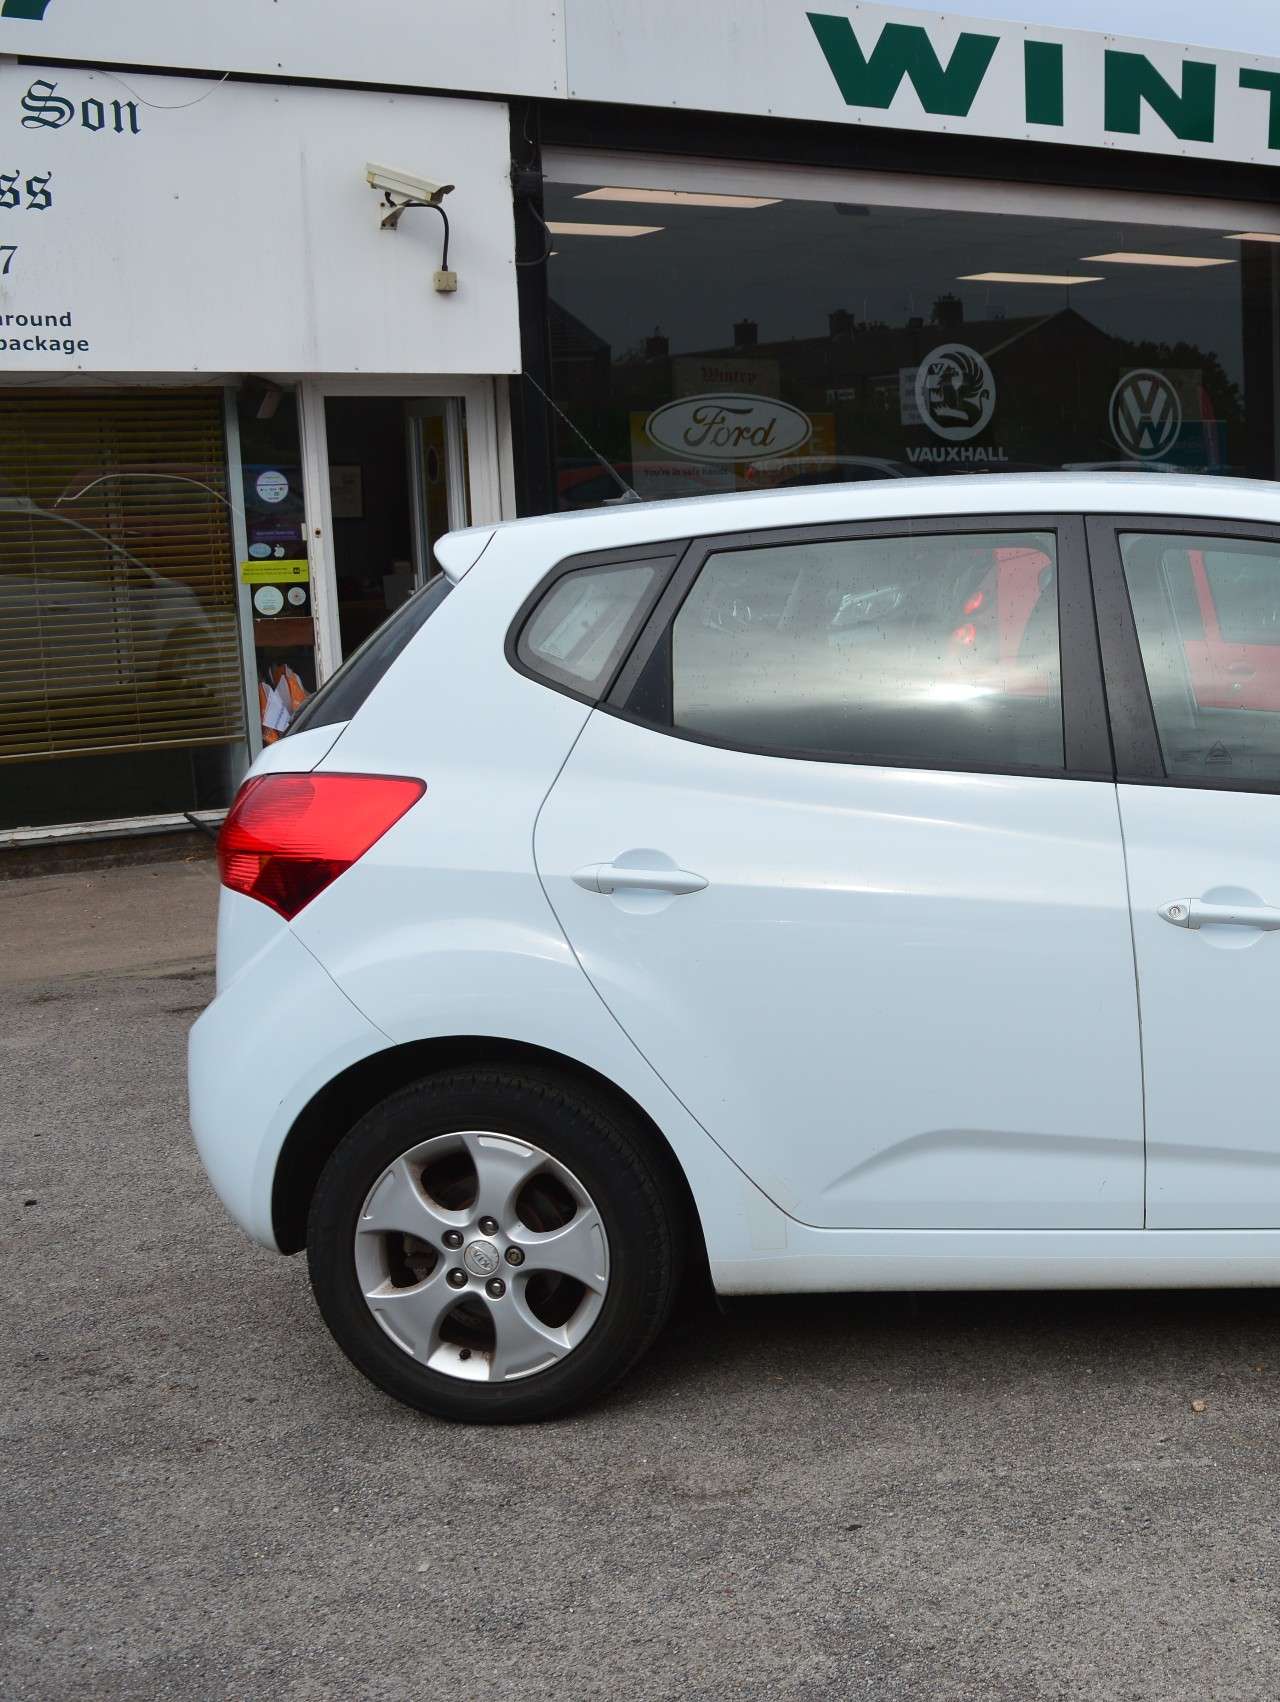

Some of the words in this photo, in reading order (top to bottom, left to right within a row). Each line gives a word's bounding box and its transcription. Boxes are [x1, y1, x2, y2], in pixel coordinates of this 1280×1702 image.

[20, 79, 142, 135] Son
[0, 311, 72, 327] round
[683, 404, 776, 448] Ford
[905, 446, 1009, 463] VAUXHALL
